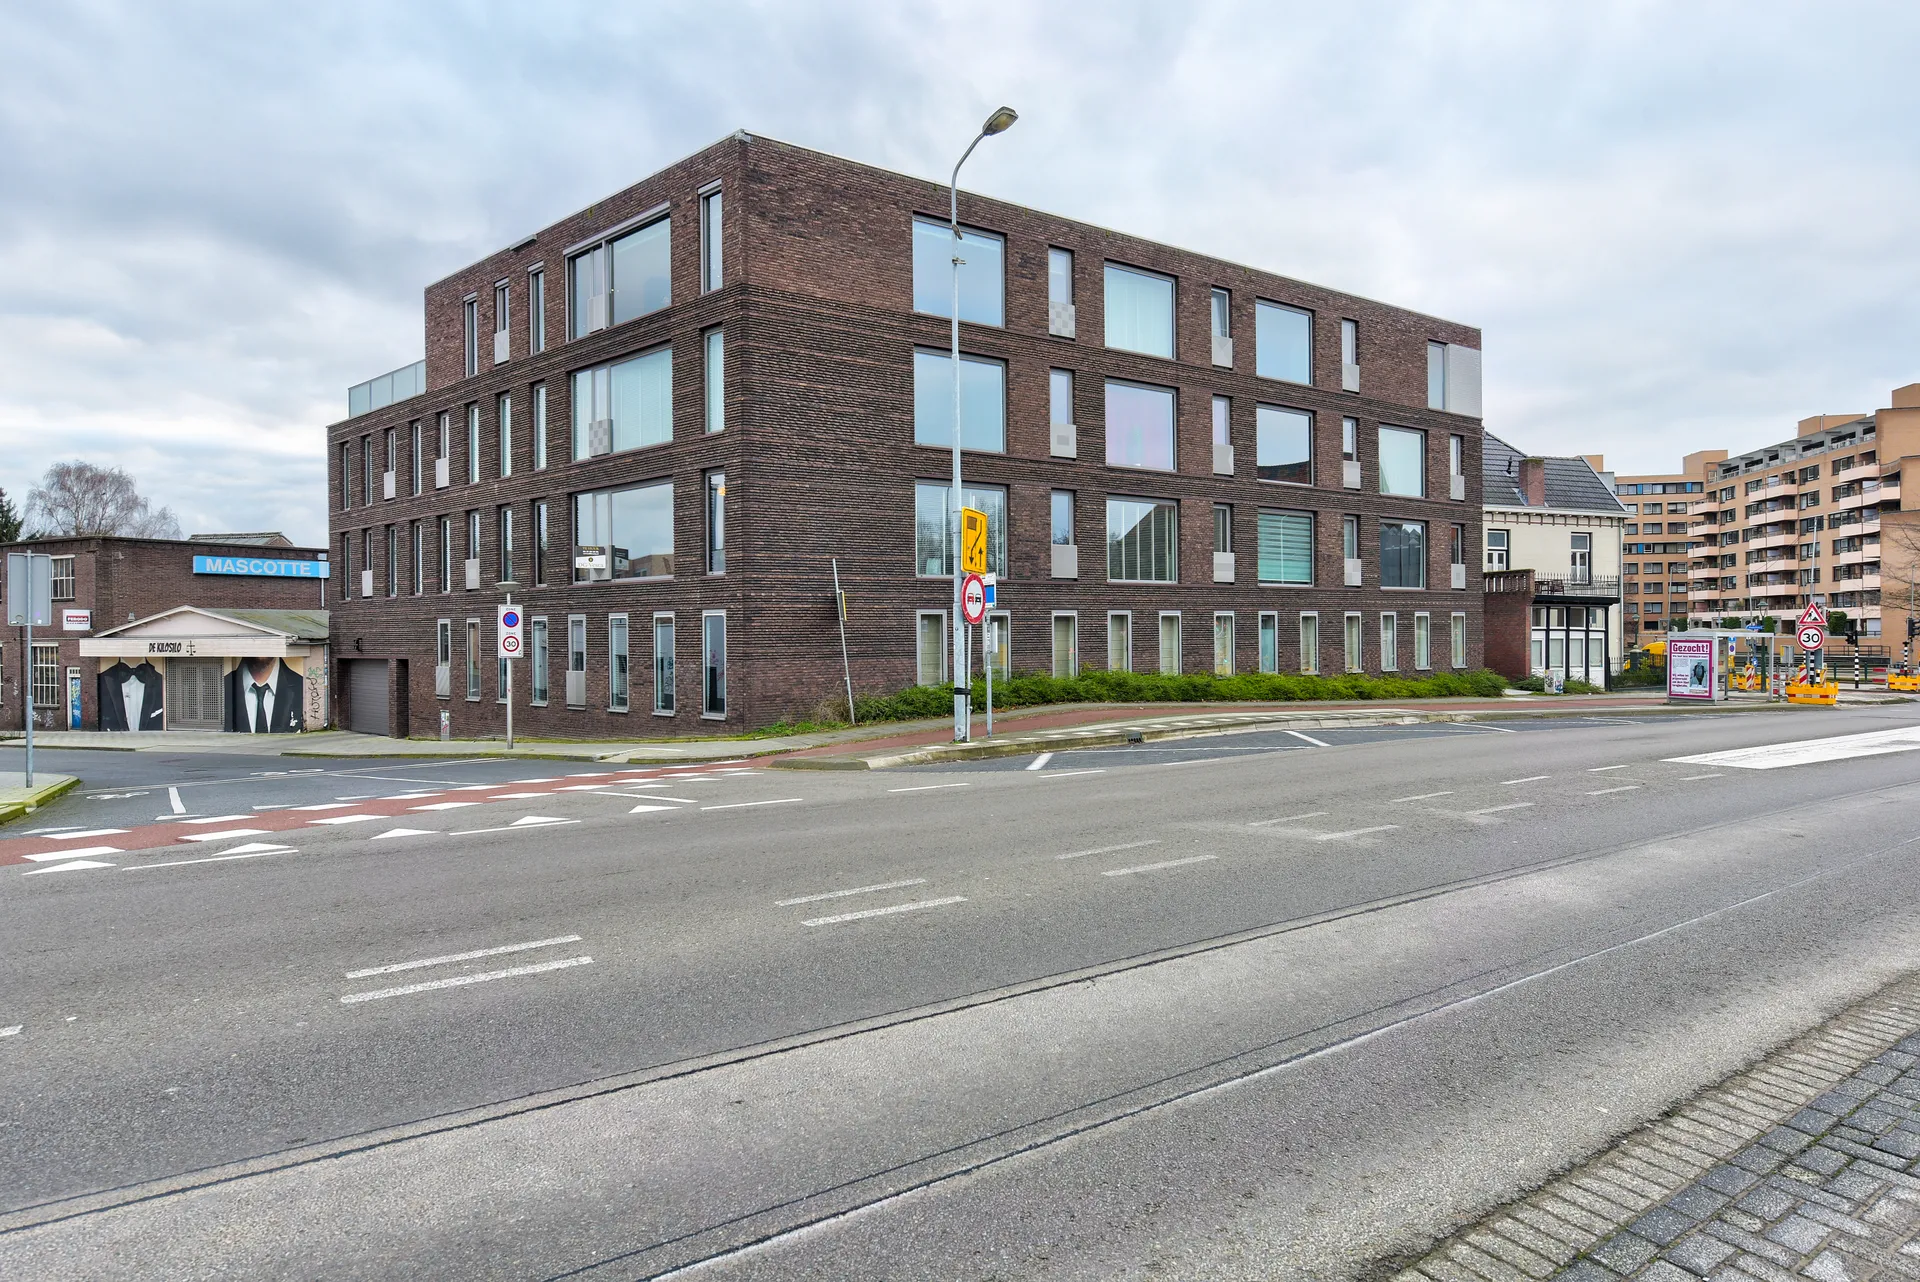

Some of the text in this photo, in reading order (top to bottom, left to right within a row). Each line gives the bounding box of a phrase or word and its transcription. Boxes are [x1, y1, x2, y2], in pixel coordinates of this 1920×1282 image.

[206, 558, 311, 575] MASCOTTE
[1802, 633, 1820, 643] 30
[149, 642, 156, 653] DE
[1673, 643, 1708, 653] Gezocht!
